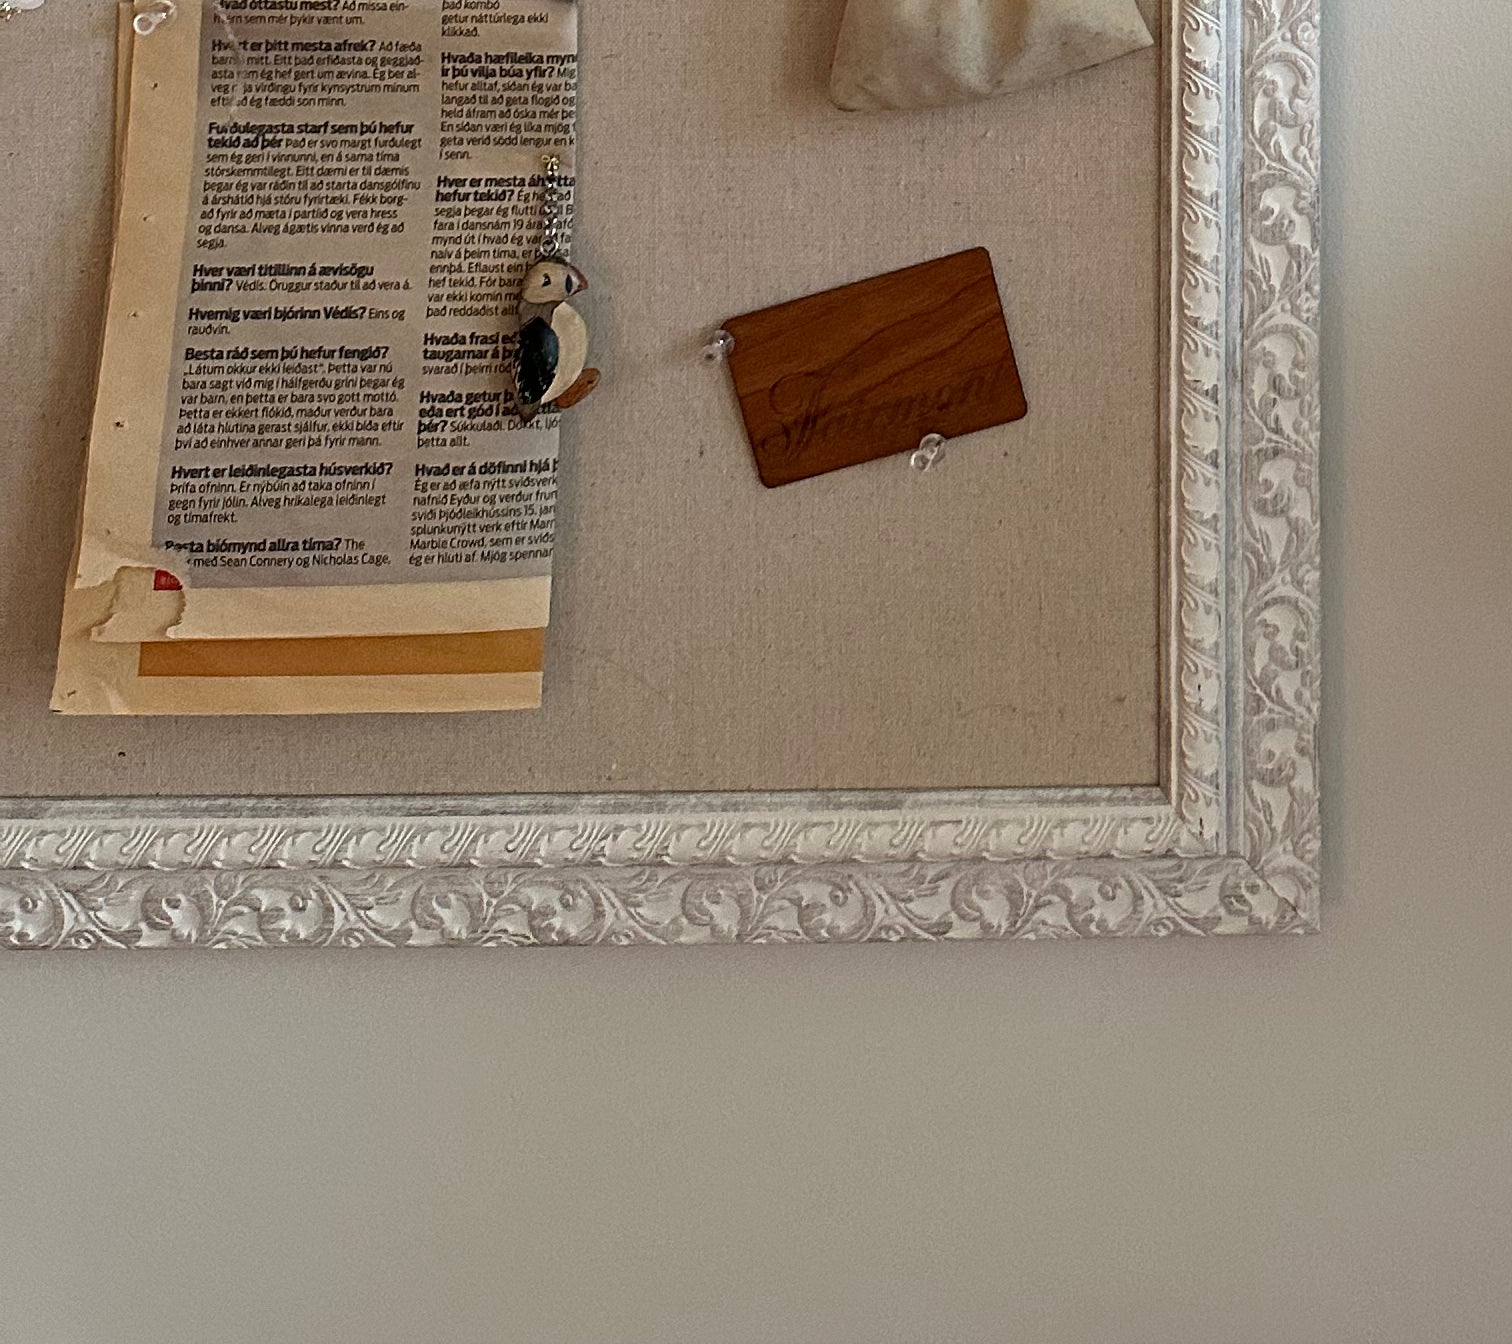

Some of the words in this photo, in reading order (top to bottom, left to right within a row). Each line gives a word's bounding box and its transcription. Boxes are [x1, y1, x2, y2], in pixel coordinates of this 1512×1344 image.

[300, 0, 340, 11] mest?
[343, 0, 355, 11] Að
[358, 1, 387, 11] missa
[464, 0, 500, 10] kombó
[442, 15, 468, 25] getur
[527, 14, 549, 23] ekki
[211, 39, 249, 52] Hvrt
[251, 42, 263, 51] er
[265, 40, 288, 54] þitt
[291, 41, 333, 51] mesta
[334, 39, 376, 51] afrek?
[379, 41, 394, 51] Að
[441, 52, 482, 64] Hvaða
[452, 67, 468, 79] þú
[471, 67, 496, 79] vilja
[499, 66, 524, 77] búa
[525, 67, 554, 80] yfir?
[297, 121, 329, 133] starf
[330, 124, 357, 134] sem
[360, 122, 377, 136] þú
[379, 121, 414, 134] hefur
[193, 264, 224, 276] Hver
[308, 263, 317, 276] á
[350, 280, 360, 290] til
[362, 280, 376, 290] að
[378, 281, 400, 290] vera
[188, 307, 240, 322] Hvernig
[368, 309, 390, 319] Eins
[392, 310, 405, 320] og
[185, 348, 224, 360] Besta
[227, 346, 249, 360] ráð
[251, 350, 278, 360] sem
[281, 346, 299, 361] þú
[301, 346, 336, 359] hefur
[171, 465, 211, 479] Hvert
[213, 468, 225, 479] er
[415, 463, 450, 476] Hvað
[452, 466, 466, 476] er
[468, 461, 476, 475] á
[269, 539, 299, 551] allra
[345, 539, 365, 551] The
[219, 556, 247, 567] Sean
[249, 556, 293, 569] Connery
[296, 556, 310, 569] og
[312, 555, 359, 566] Nicholas
